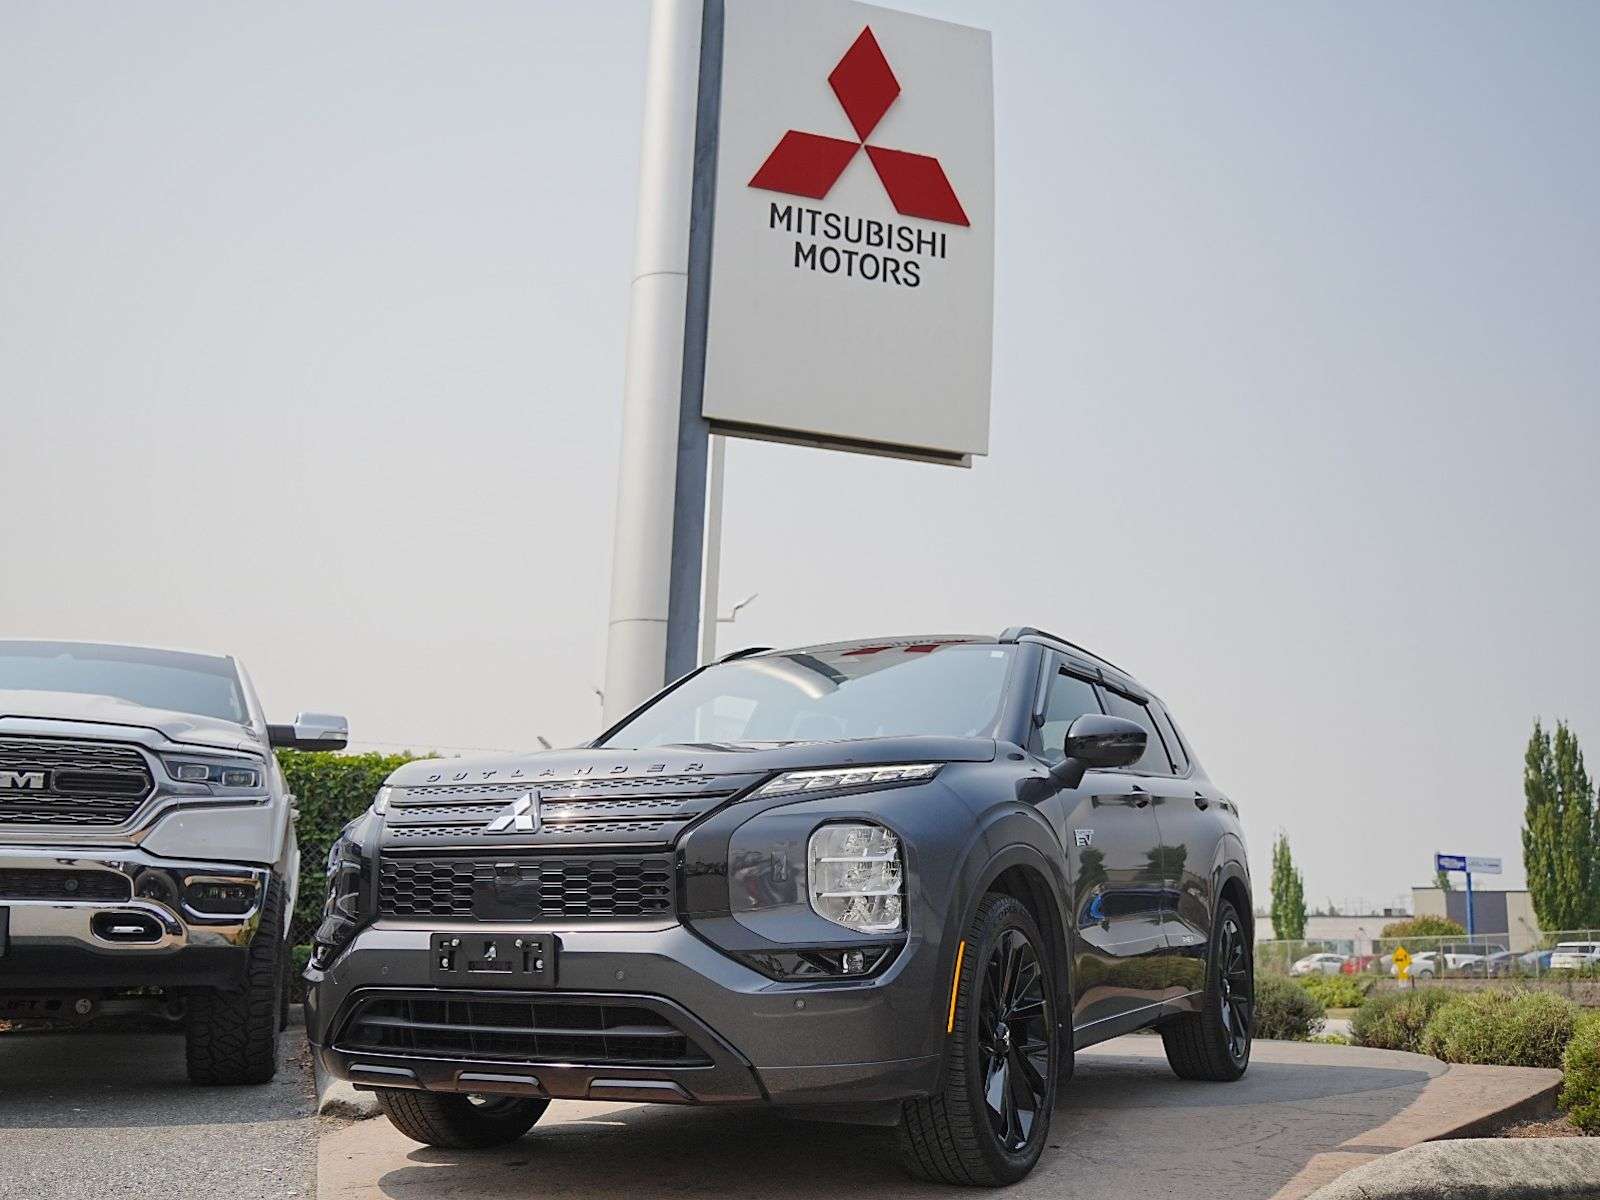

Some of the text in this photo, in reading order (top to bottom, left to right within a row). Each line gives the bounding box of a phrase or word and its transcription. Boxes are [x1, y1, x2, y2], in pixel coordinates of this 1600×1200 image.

[769, 202, 947, 259] MITSUBISHI
[794, 241, 921, 288] MOTORS
[426, 762, 704, 783] OUTLANDER
